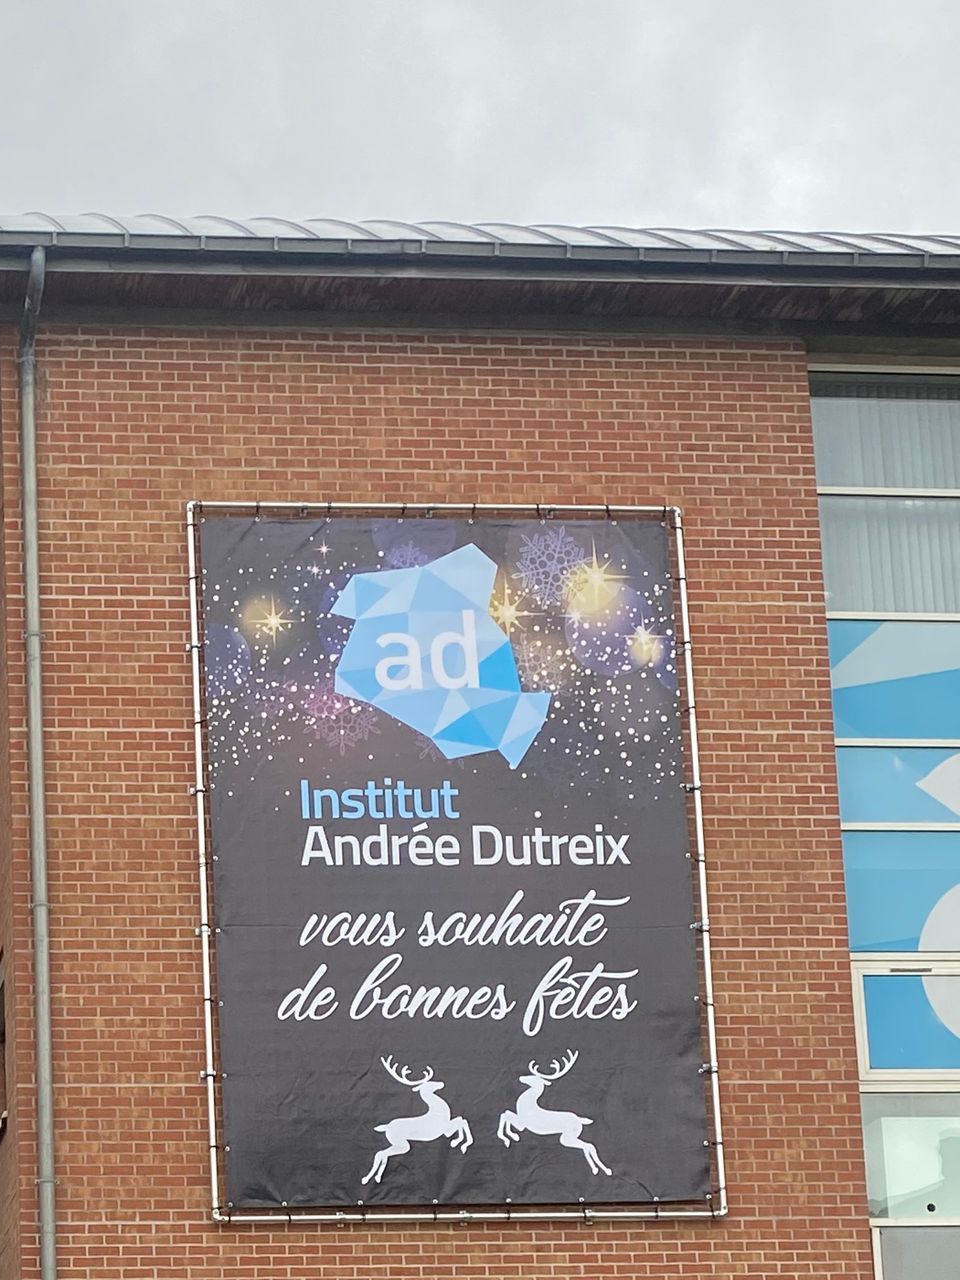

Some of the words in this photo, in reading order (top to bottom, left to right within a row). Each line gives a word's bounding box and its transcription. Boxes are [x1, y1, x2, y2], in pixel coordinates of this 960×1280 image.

[374, 609, 480, 691] ad
[300, 777, 461, 820] Institut
[300, 821, 461, 866] Andrée
[471, 823, 632, 866] Dutreix
[299, 910, 406, 947] vous
[417, 889, 631, 947] souhaite
[277, 963, 339, 1021] de
[349, 953, 517, 1020] bonnes
[522, 955, 639, 1037] fêtes
